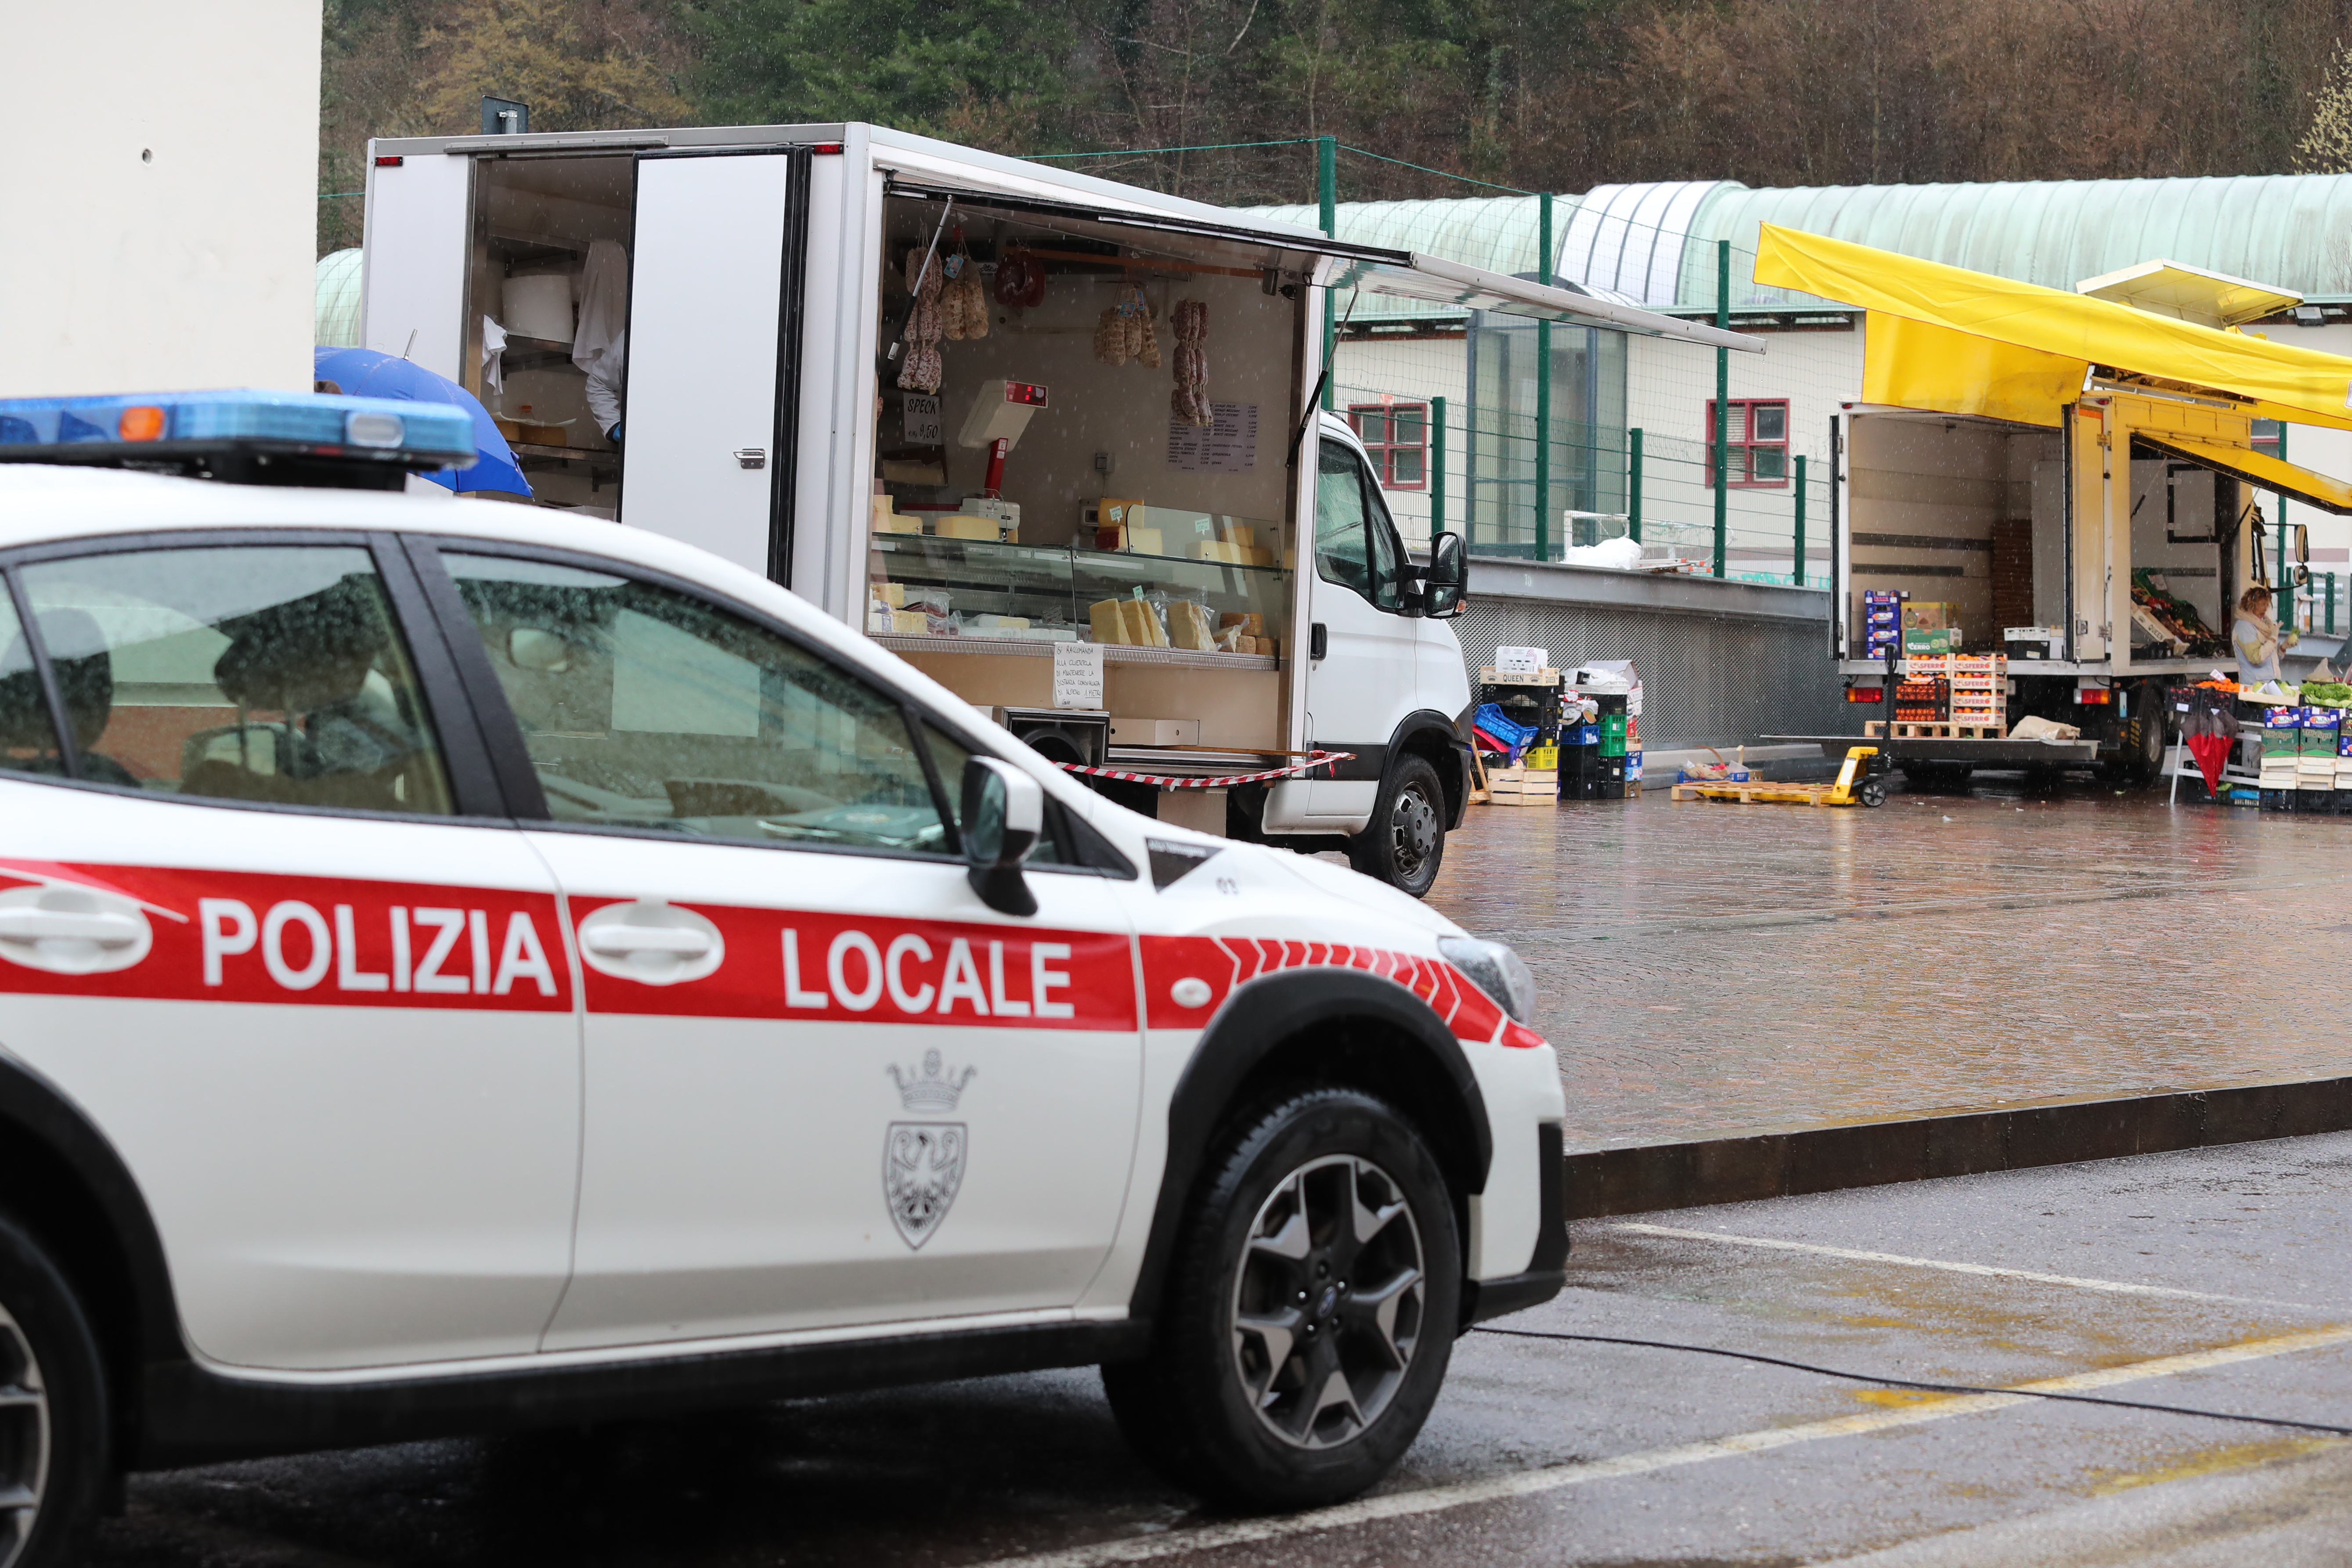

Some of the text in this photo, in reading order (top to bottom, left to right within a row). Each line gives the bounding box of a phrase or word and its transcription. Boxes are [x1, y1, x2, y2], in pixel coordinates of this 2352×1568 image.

[908, 399, 938, 415] SPECK
[1067, 645, 1093, 654] RACCOMANDA
[1503, 674, 1524, 683] QUEEN
[198, 896, 558, 997] POLIZIA
[782, 927, 1075, 1018] LOCALE
